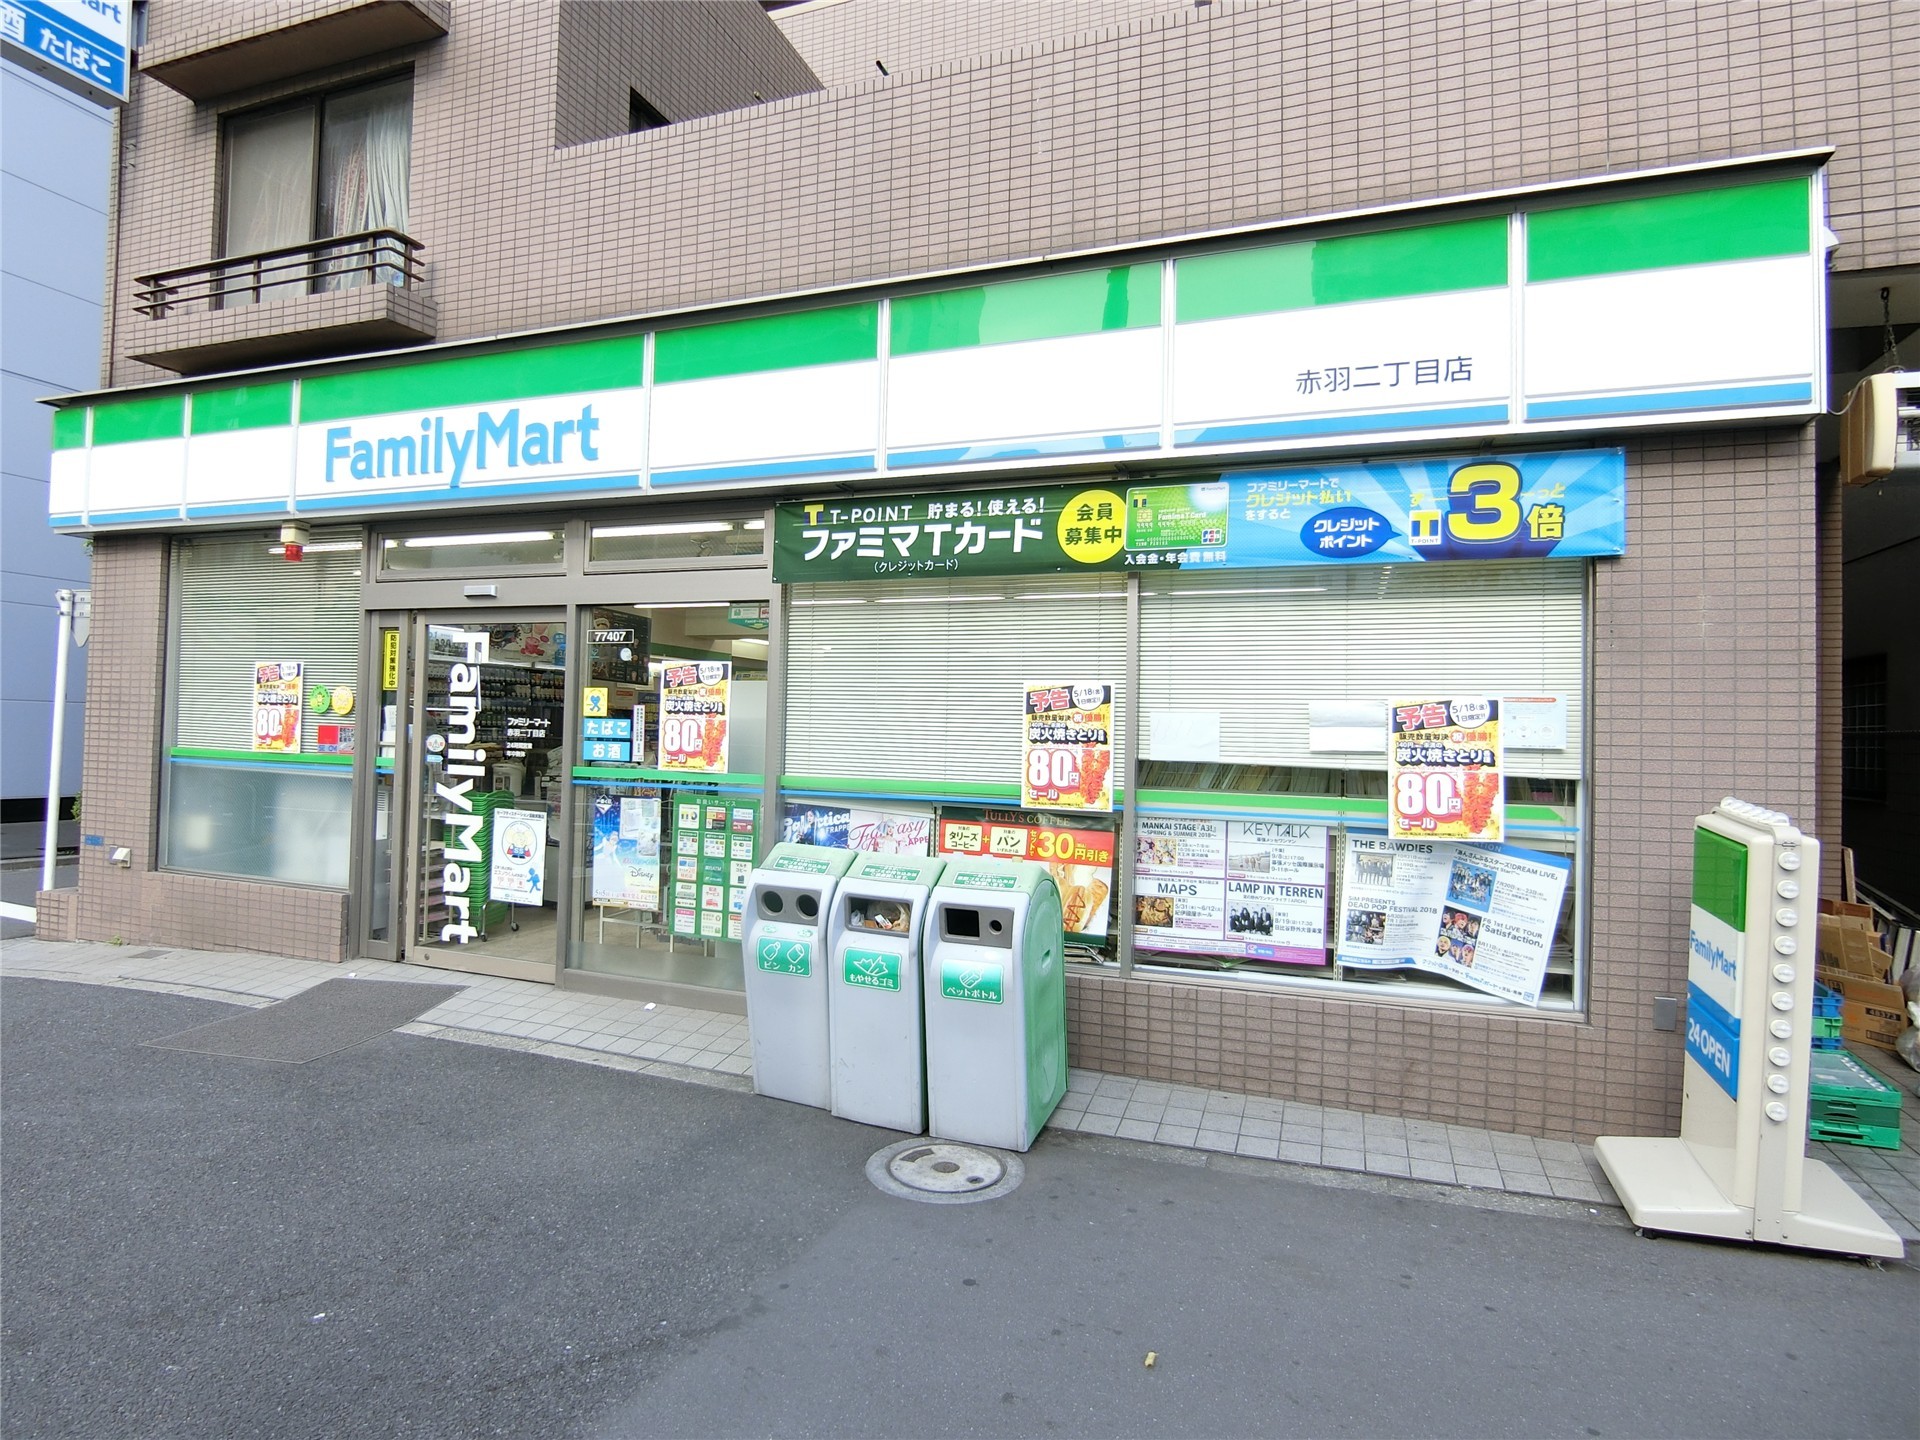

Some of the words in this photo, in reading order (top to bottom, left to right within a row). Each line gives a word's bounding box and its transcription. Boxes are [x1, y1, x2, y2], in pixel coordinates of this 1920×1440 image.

[40, 27, 112, 84] たばこ
[1296, 356, 1473, 395] 赤羽二丁目店
[325, 404, 600, 488] FamilyMart
[1247, 478, 1340, 493] ファミリーマートで
[1246, 491, 1352, 508] クレジット払い
[1447, 463, 1521, 542] 3
[1526, 505, 1564, 540] 倍
[830, 505, 913, 525] T-POINT
[1076, 502, 1113, 522] 会員
[1245, 508, 1291, 521] をすると
[1314, 517, 1380, 533] クレジット
[802, 518, 1043, 561] ファミマTカード
[1065, 526, 1122, 546] 募集中
[1319, 534, 1373, 549] ポイント
[874, 558, 959, 573] (クレジットカード)
[1124, 554, 1200, 566] 入会金・年会費
[595, 631, 626, 642] 77407
[259, 665, 280, 683] 予告
[667, 666, 697, 687] 予告
[1030, 690, 1070, 713] 予告
[1452, 703, 1488, 714] 5/18(金)
[507, 718, 551, 727] ファミリーマート
[1397, 704, 1447, 732] 予告
[507, 729, 546, 738] 赤羽二丁目店
[586, 720, 629, 736] たばこ
[593, 743, 621, 759] お酒
[436, 631, 490, 944] FamilyMart
[1028, 788, 1058, 799] セール
[984, 809, 1024, 822] TULLY'S
[1026, 814, 1070, 826] COFFEE
[1397, 817, 1435, 829] セール
[1141, 822, 1172, 830] MANKAI
[1243, 822, 1310, 838] KEYTALK
[949, 832, 978, 842] タリーズ
[997, 836, 1021, 848] パン
[1029, 829, 1038, 857] セットで
[1036, 831, 1074, 859] 30
[1352, 839, 1376, 850] THE
[1378, 842, 1434, 854] BAWDIES
[1074, 848, 1109, 863] 円引き
[629, 865, 654, 881] Disney
[1157, 882, 1198, 896] MAPS
[1228, 882, 1260, 894] LAMP
[1263, 885, 1275, 895] IN
[1279, 886, 1323, 899] TERREN
[1347, 901, 1370, 909] DEAD
[1371, 903, 1388, 911] POP
[1389, 905, 1419, 913] FESTIVAL
[1419, 906, 1438, 914] 2018
[1361, 896, 1396, 906] PRESENTS
[1504, 924, 1522, 934] LIVE
[1522, 929, 1544, 940] TOUR
[1690, 930, 1737, 981] FamilyMart
[764, 961, 781, 970] ビン
[788, 964, 805, 973] カン
[849, 974, 894, 988] もやせるゴミ
[946, 986, 998, 999] ペットボトル
